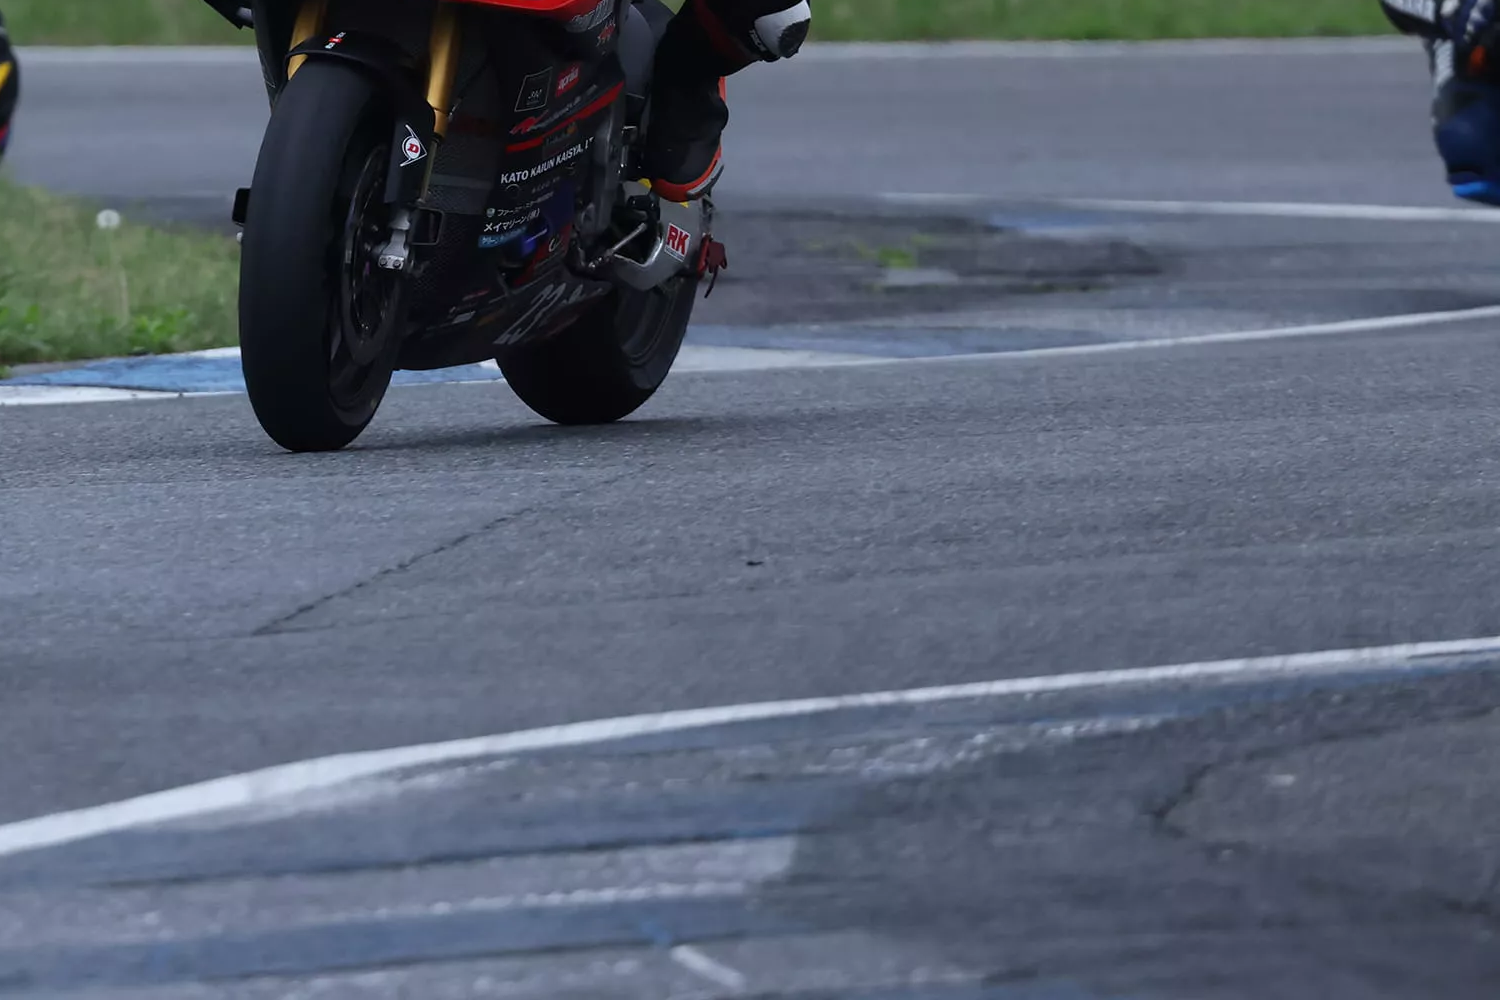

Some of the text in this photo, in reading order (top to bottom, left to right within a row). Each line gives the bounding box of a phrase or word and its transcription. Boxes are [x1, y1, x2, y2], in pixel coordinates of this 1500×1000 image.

[501, 170, 529, 184] KATO
[530, 159, 555, 178] KAIUN
[666, 225, 689, 256] RK
